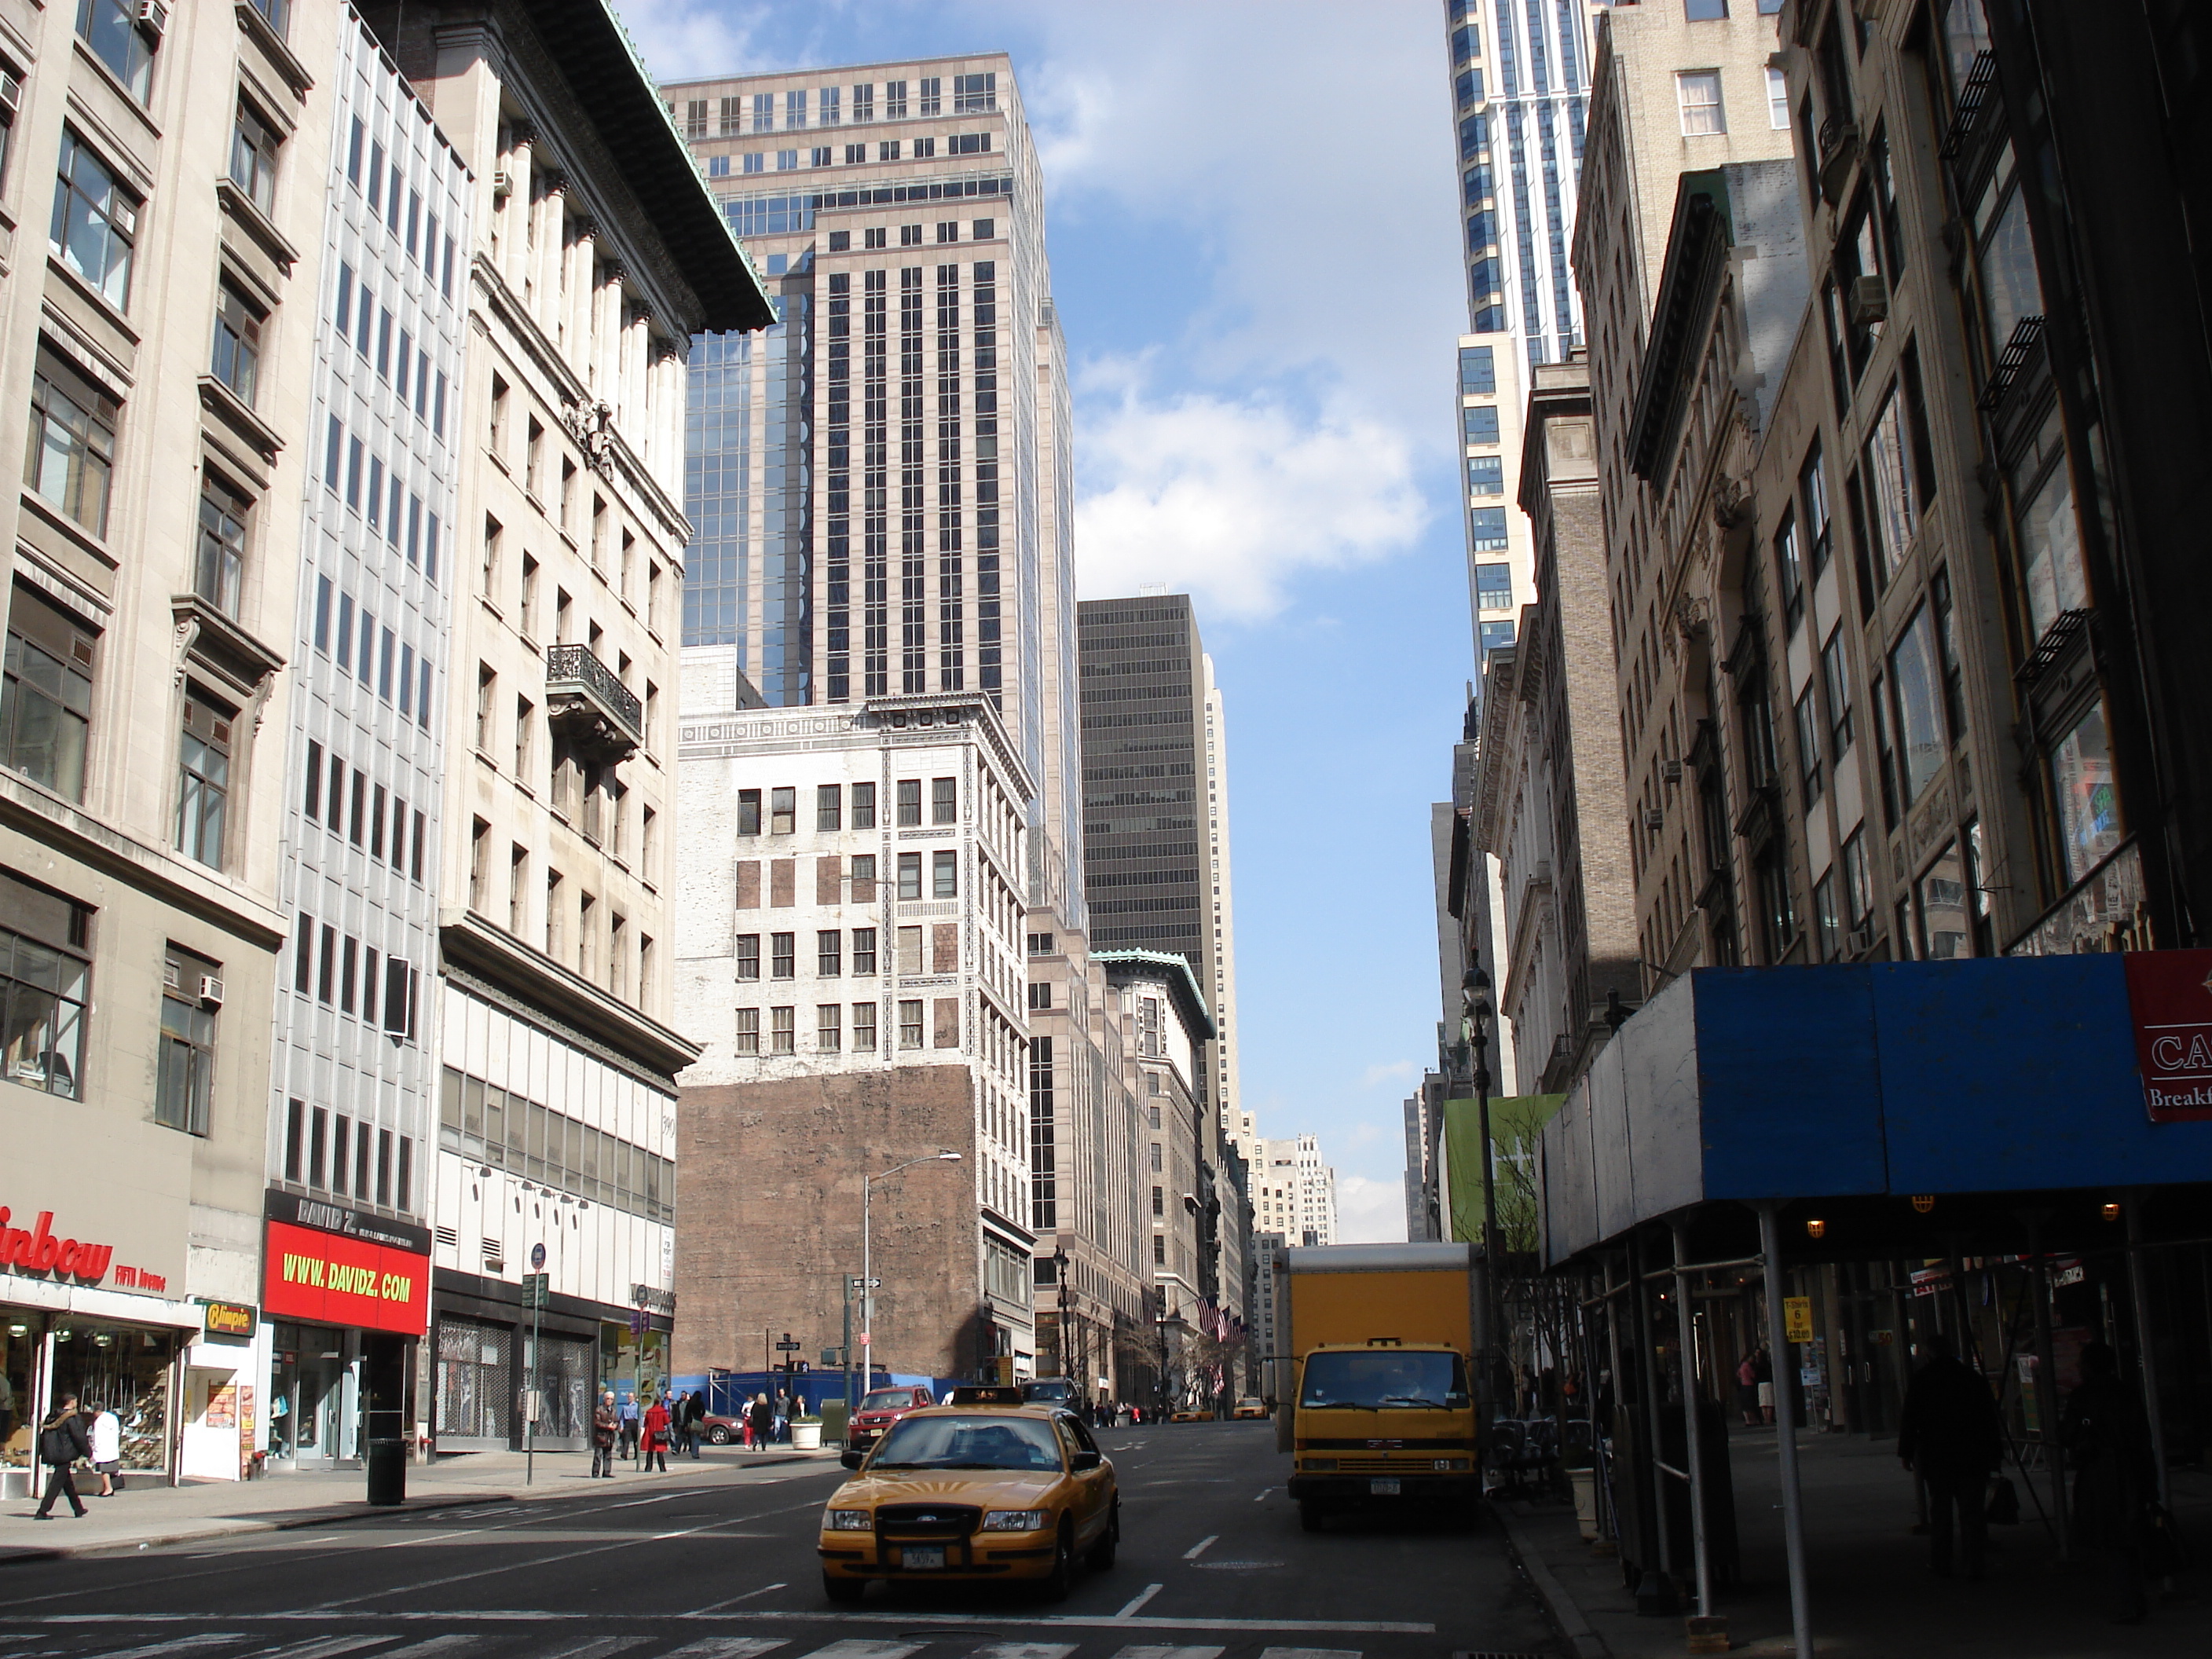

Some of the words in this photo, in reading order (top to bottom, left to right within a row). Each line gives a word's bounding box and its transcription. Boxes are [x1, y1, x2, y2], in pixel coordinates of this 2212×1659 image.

[2152, 1033, 2212, 1070] CA
[662, 1115, 675, 1138] 390
[297, 1199, 342, 1230] DAVID
[207, 1303, 250, 1331] Blimpie
[1794, 1309, 1800, 1320] 6
